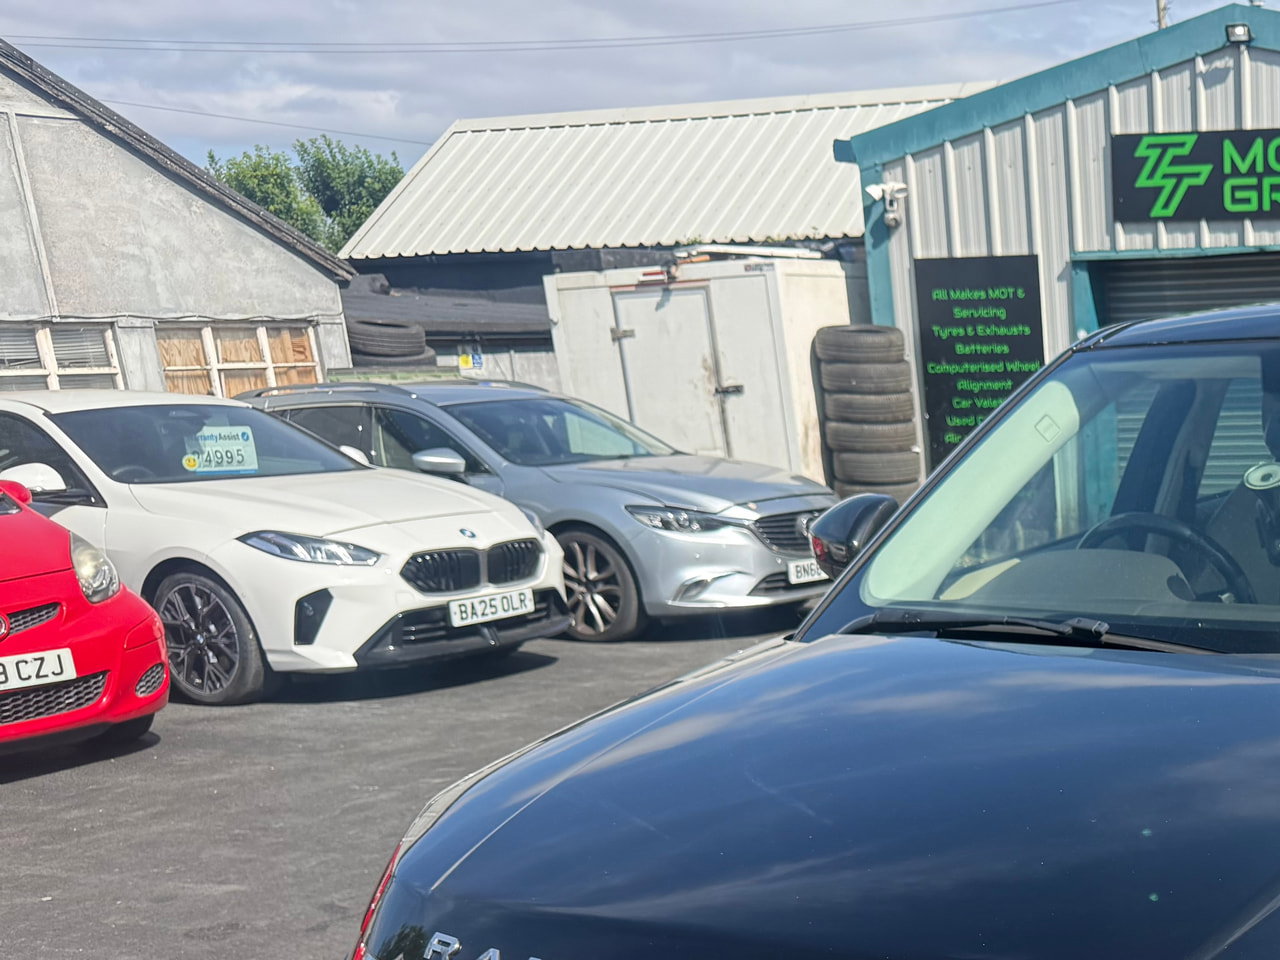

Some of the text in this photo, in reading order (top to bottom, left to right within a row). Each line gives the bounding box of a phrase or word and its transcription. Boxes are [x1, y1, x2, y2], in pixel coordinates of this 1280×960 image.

[932, 288, 948, 299] All
[949, 288, 986, 299] Makes
[988, 287, 1014, 299] MOT
[953, 306, 1007, 320] Servicing
[932, 325, 965, 339] Tyres
[976, 324, 1031, 336] Exhausts
[955, 343, 1009, 354] Batteries
[927, 360, 1040, 375] Computerised Wheel
[956, 379, 1013, 393] Alignment
[952, 397, 972, 408] Car
[946, 415, 975, 426] Used
[458, 592, 528, 620] BA25 OLR
[15, 654, 63, 681] CZJ
